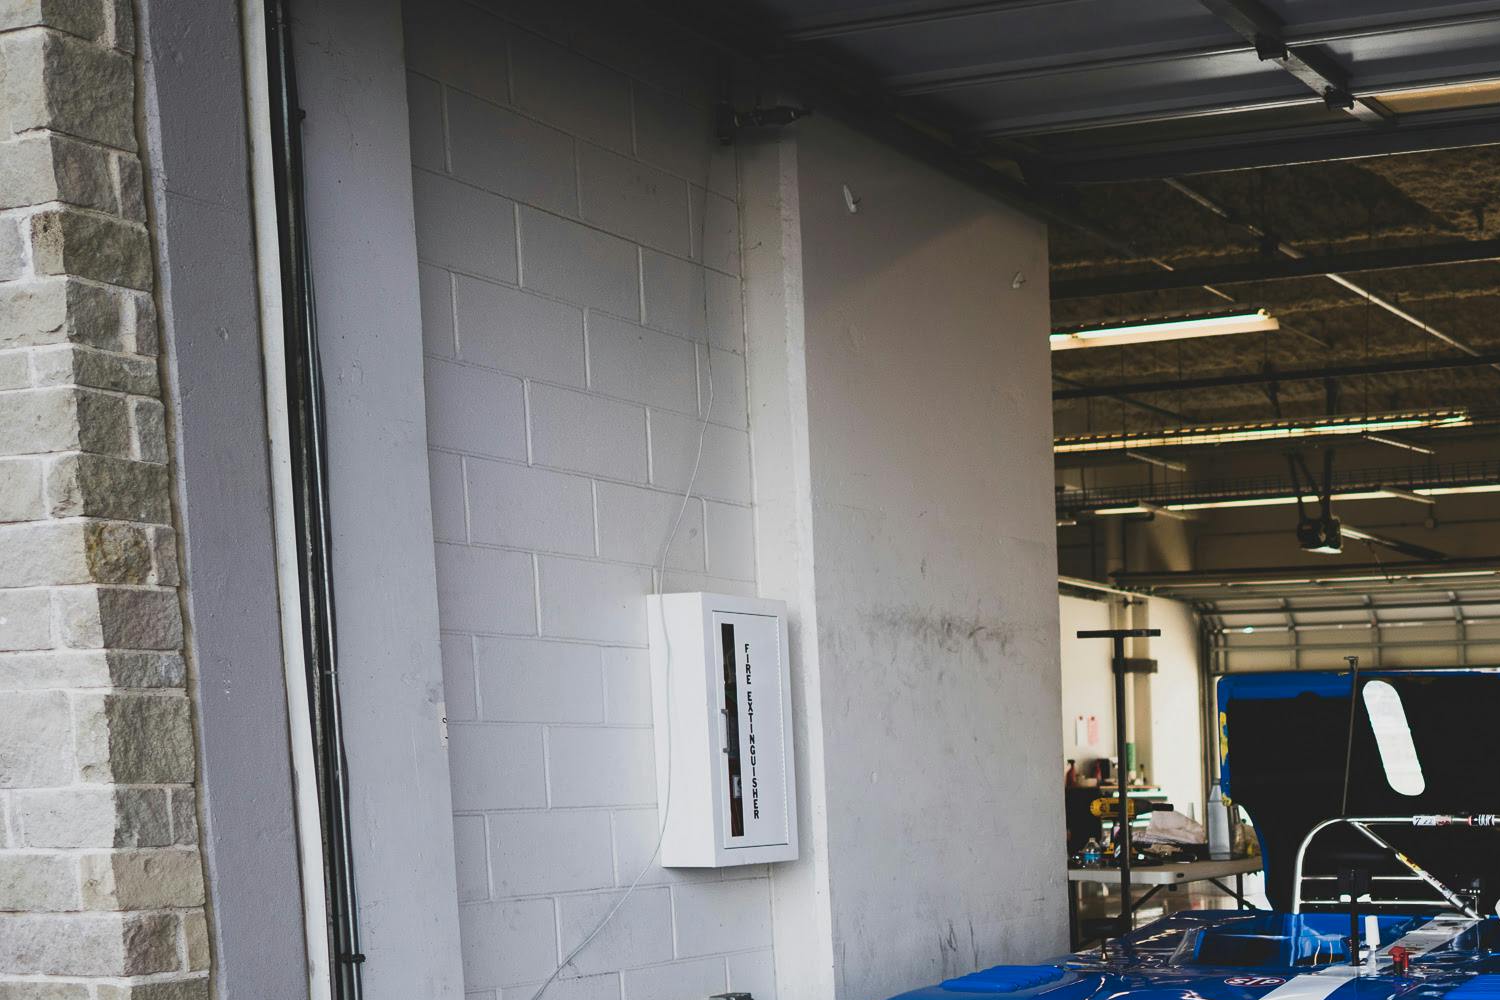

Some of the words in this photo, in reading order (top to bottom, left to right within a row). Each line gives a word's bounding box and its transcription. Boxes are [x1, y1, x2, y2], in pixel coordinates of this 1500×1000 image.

[744, 643, 752, 685] FIRE
[747, 691, 760, 819] EXTINGUISHER
[1229, 977, 1281, 985] STP
